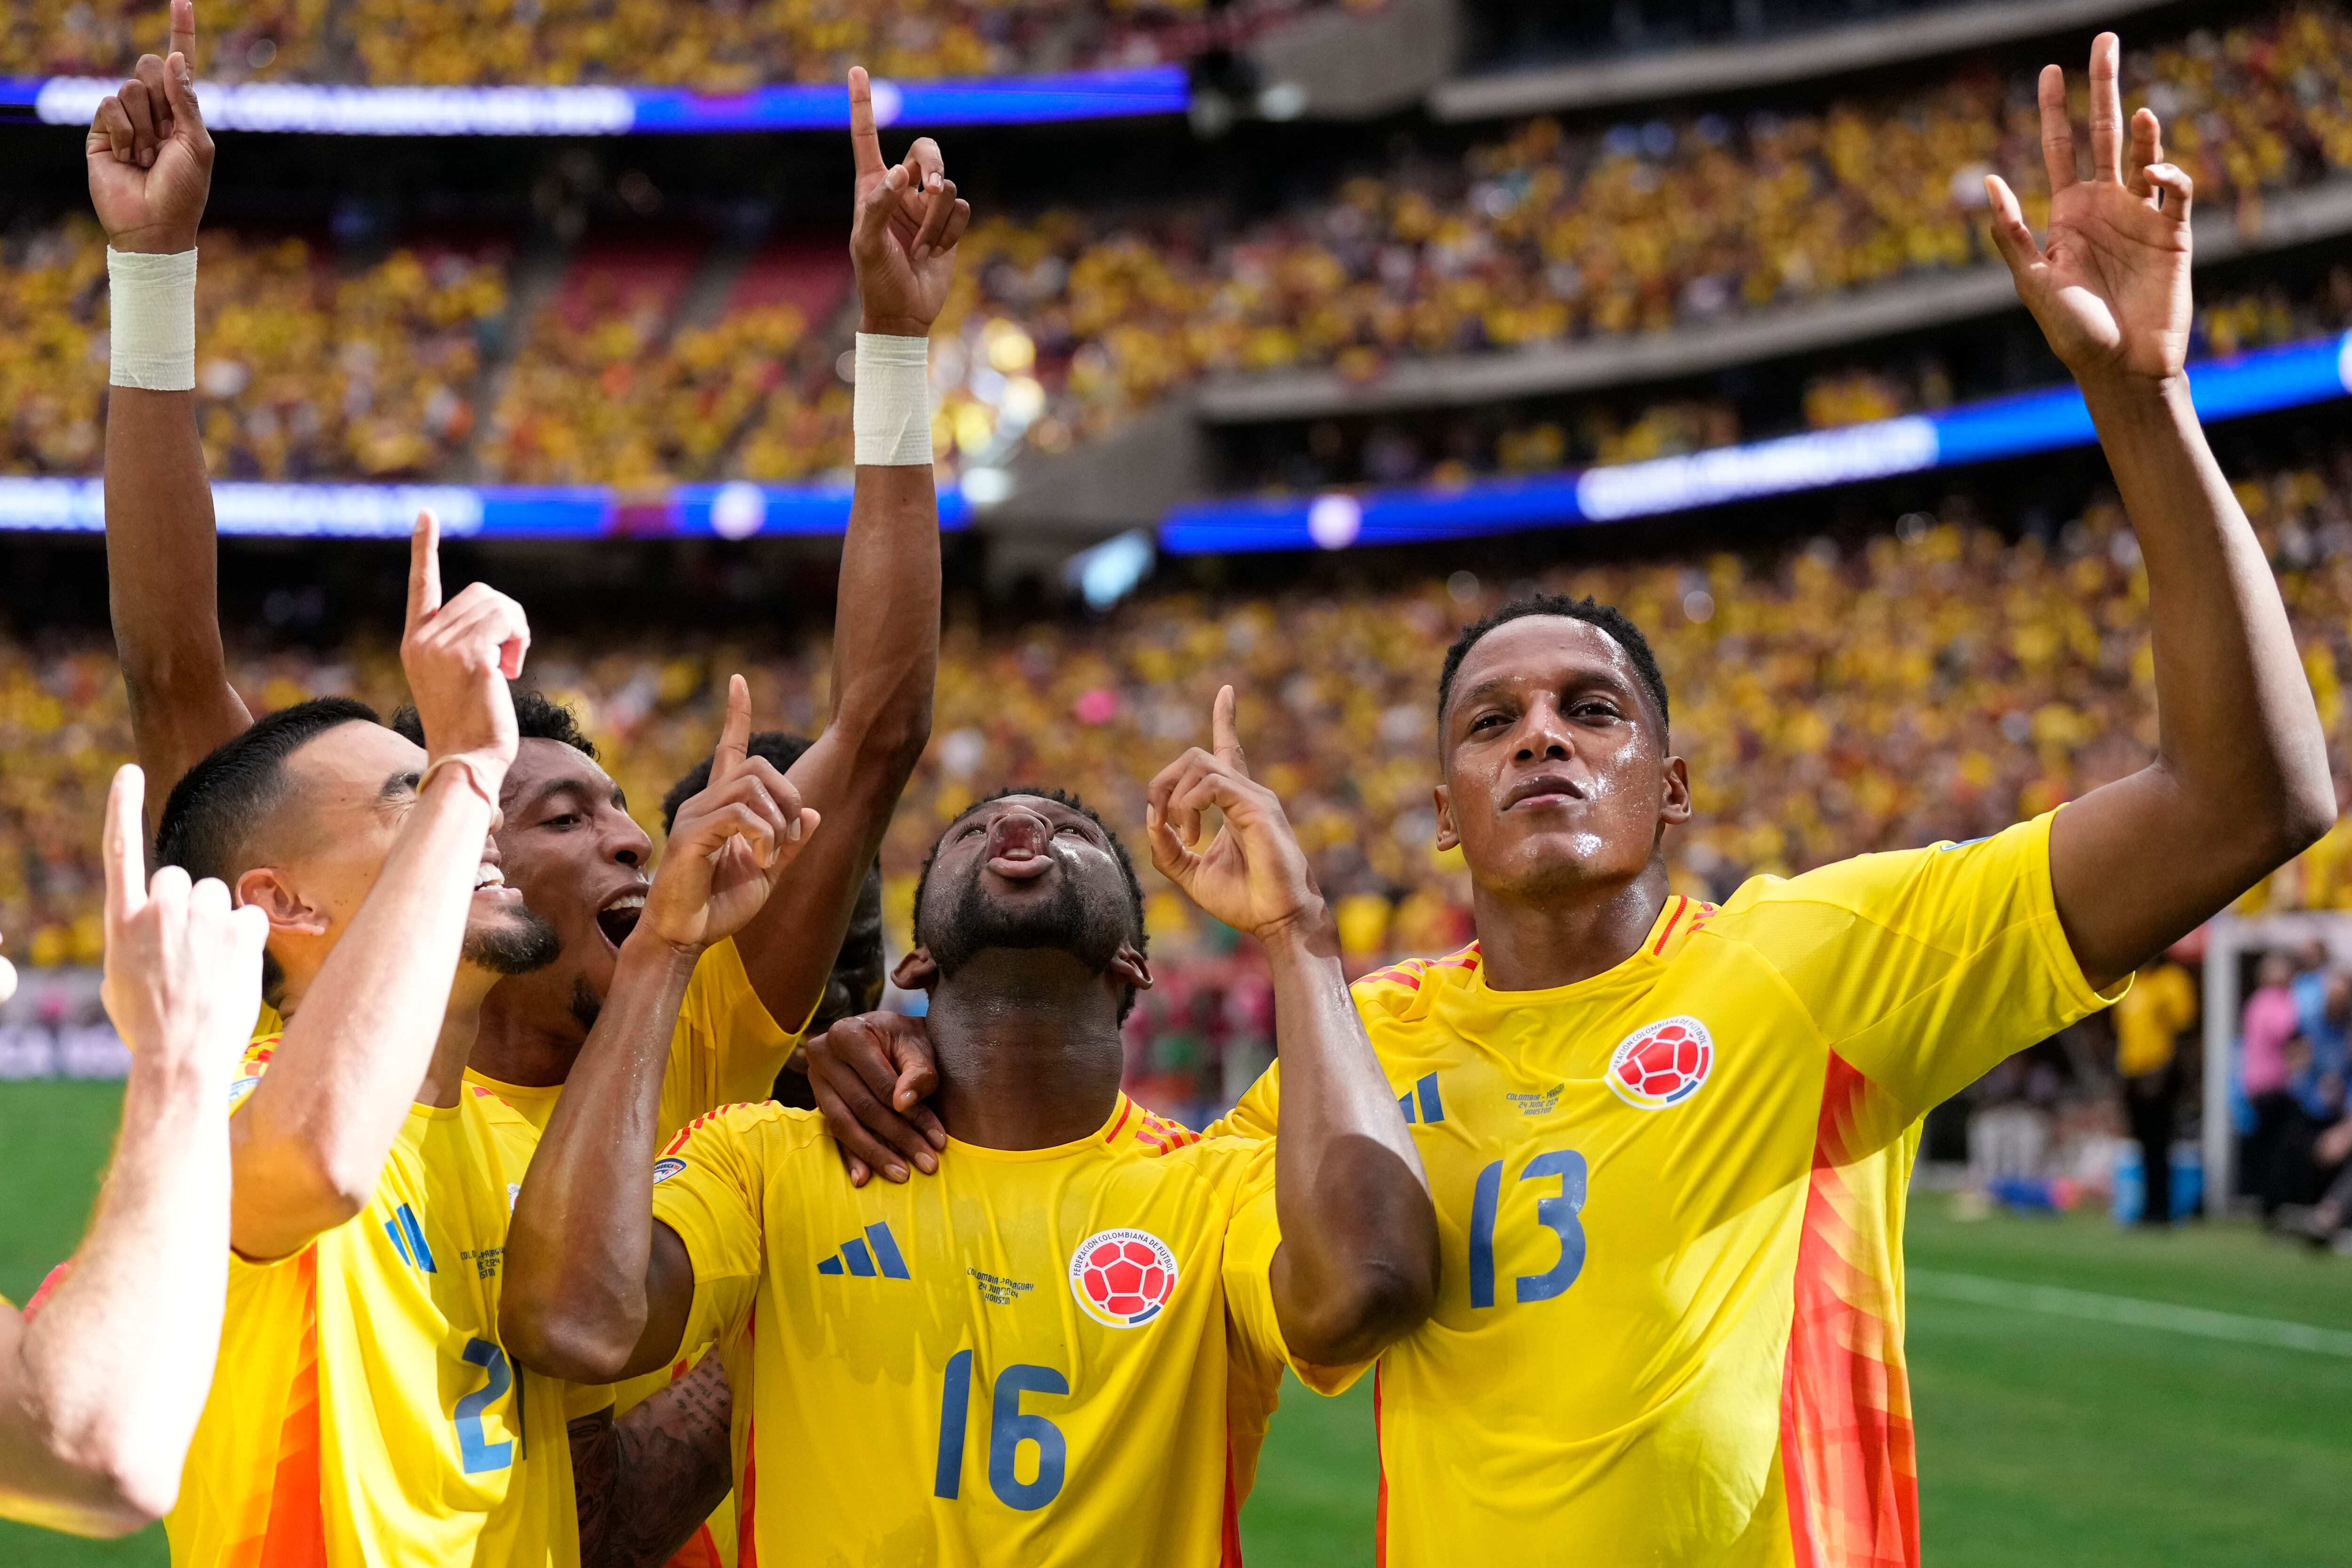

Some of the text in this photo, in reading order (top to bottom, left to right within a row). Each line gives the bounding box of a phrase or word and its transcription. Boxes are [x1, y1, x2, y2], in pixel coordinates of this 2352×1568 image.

[1633, 1019, 1678, 1042] COLOMBIANA
[1524, 1107, 1551, 1115] HOUSTON
[1469, 1149, 1587, 1309] 13
[1073, 1232, 1174, 1276] FEDERACIÓN COLOMBIANA DE FÚTBOL
[967, 1267, 999, 1284] COLOMBIA
[1002, 1278, 1034, 1291] PARAGUAY
[978, 1282, 987, 1290] 24
[985, 1293, 1010, 1305] HOUSTON
[934, 1349, 1069, 1512] 16
